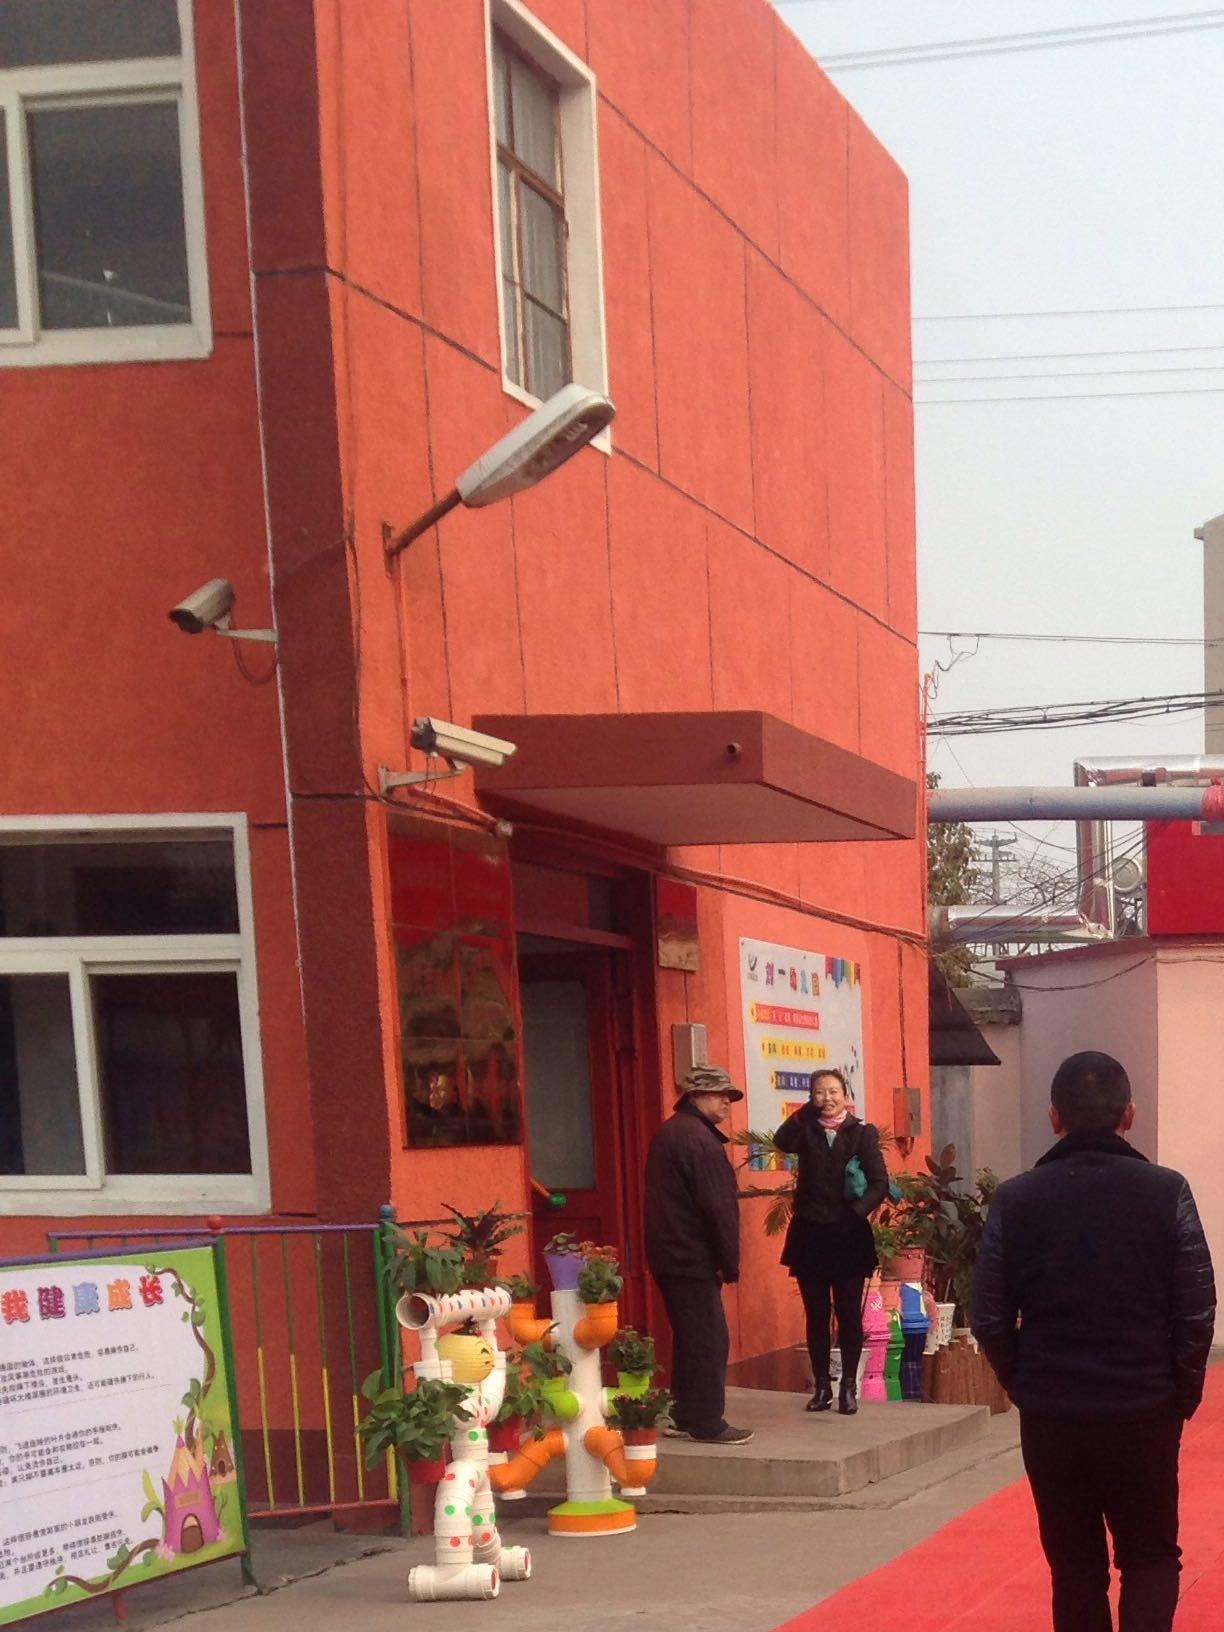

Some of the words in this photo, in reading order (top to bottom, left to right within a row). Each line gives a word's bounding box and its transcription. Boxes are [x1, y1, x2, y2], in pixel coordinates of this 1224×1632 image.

[1, 1274, 165, 1325] 我健康成长
